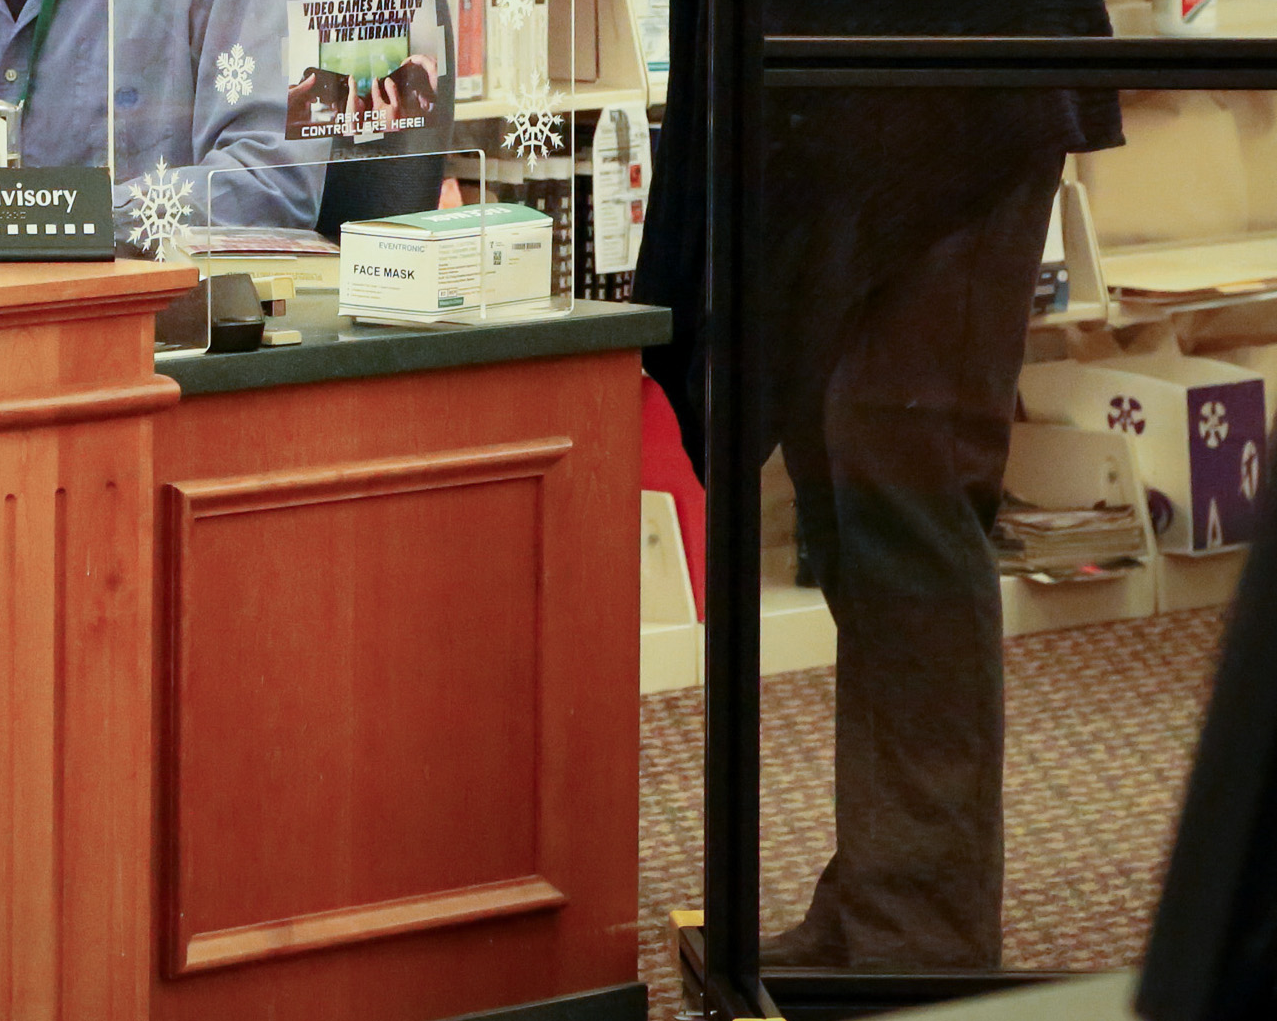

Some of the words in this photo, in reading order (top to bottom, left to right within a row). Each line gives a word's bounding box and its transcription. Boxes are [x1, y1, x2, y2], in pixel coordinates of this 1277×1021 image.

[303, 0, 335, 17] VIDEO
[308, 12, 369, 31] AVAILABLE
[372, 11, 385, 24] TO
[388, 9, 416, 24] PLAY
[319, 29, 331, 43] IN
[334, 27, 354, 42] THE
[357, 23, 408, 41] LIBRARY!
[335, 111, 360, 123] ASK
[364, 110, 387, 121] FOR
[301, 120, 388, 138] CONTROLLERS
[391, 116, 425, 129] HERE!
[378, 241, 426, 253] EVENTRONIC
[353, 264, 381, 277] FACE
[383, 267, 415, 280] MASK
